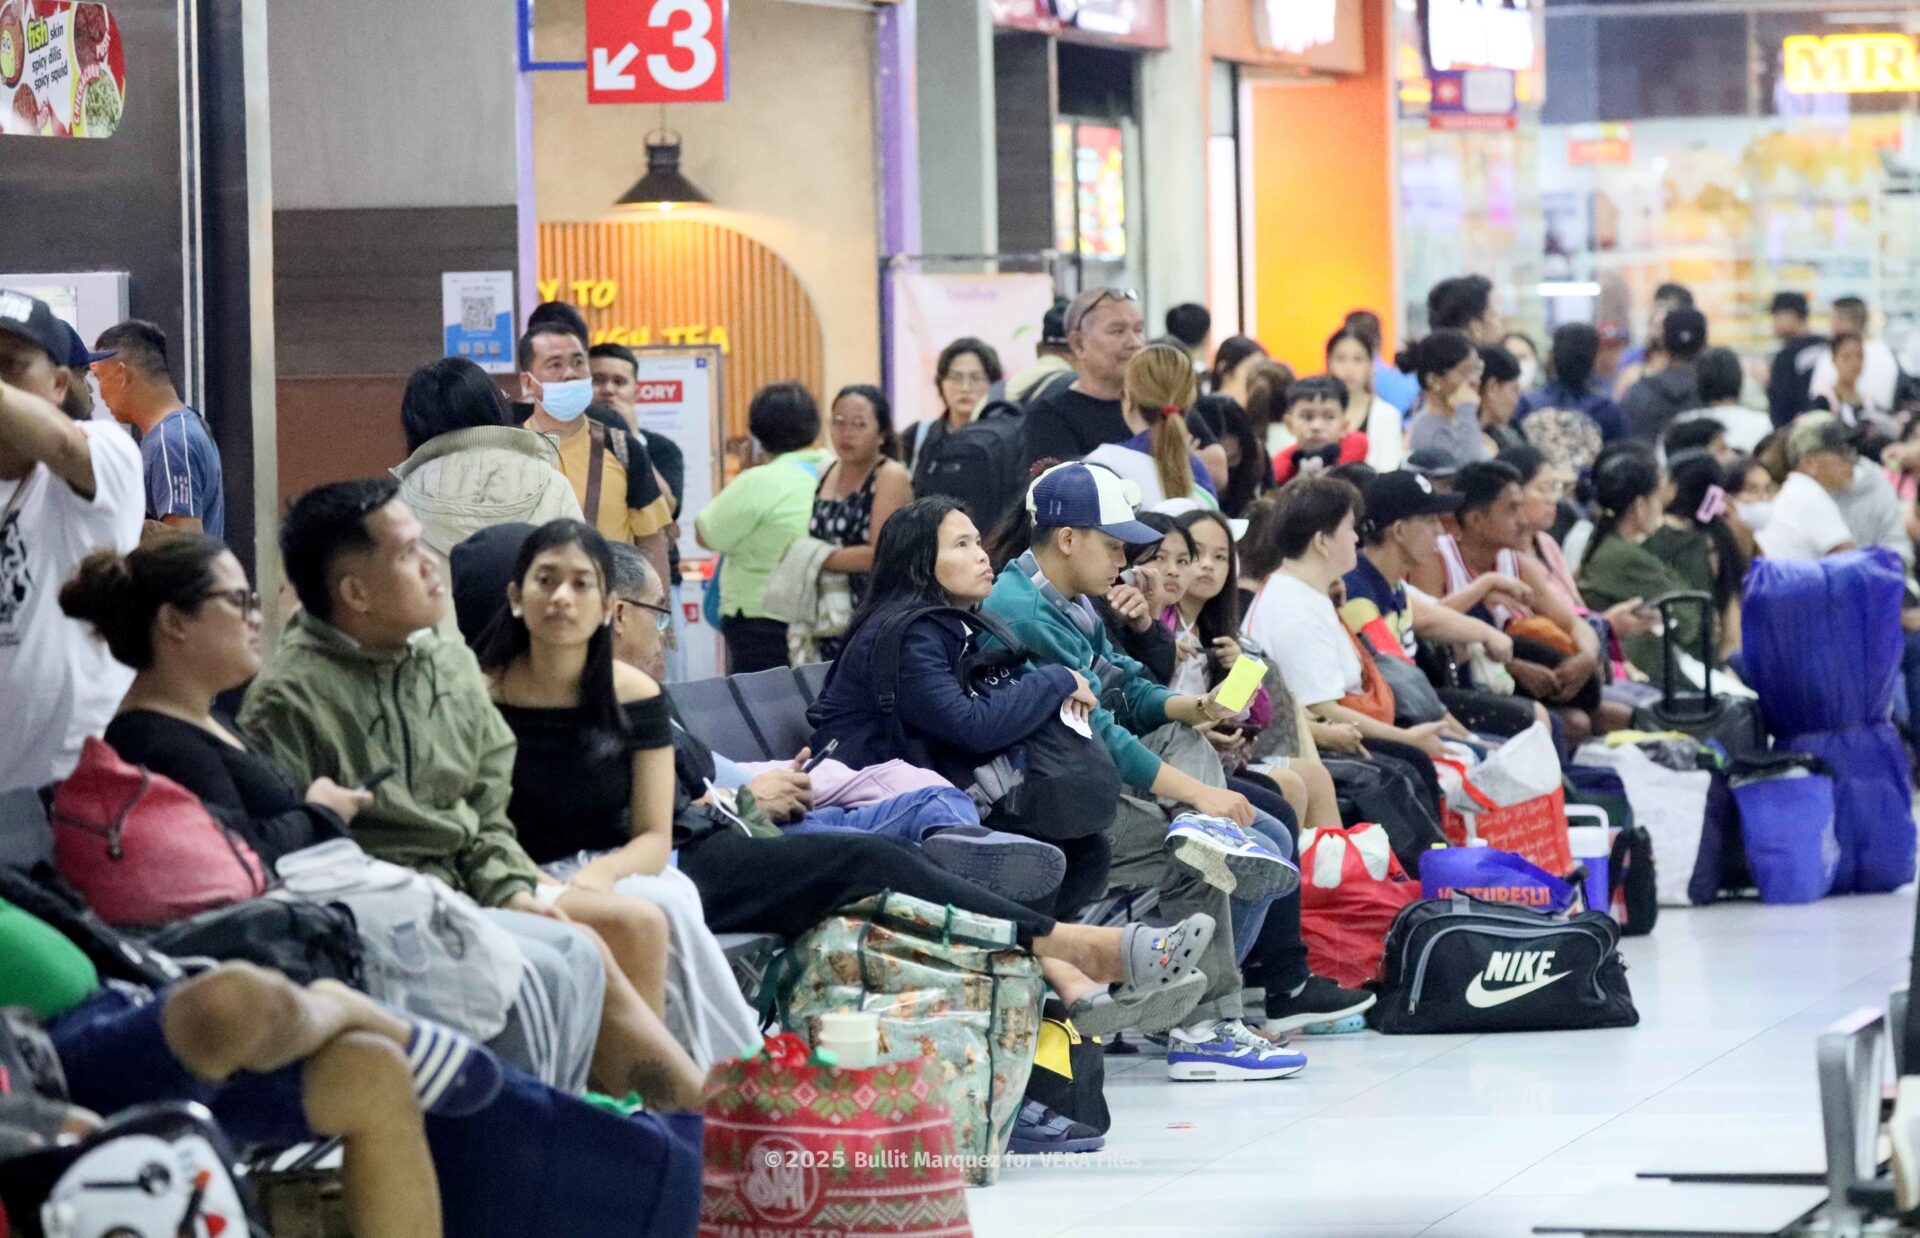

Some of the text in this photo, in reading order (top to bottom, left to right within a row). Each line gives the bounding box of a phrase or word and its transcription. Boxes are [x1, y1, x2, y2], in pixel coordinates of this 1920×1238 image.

[27, 16, 64, 54] fish skin
[646, 0, 717, 90] 3
[32, 55, 48, 74] spicy
[34, 61, 68, 92] spicy squid
[571, 279, 617, 308] TO
[661, 325, 730, 354] TEA
[1484, 950, 1556, 982] NIKE
